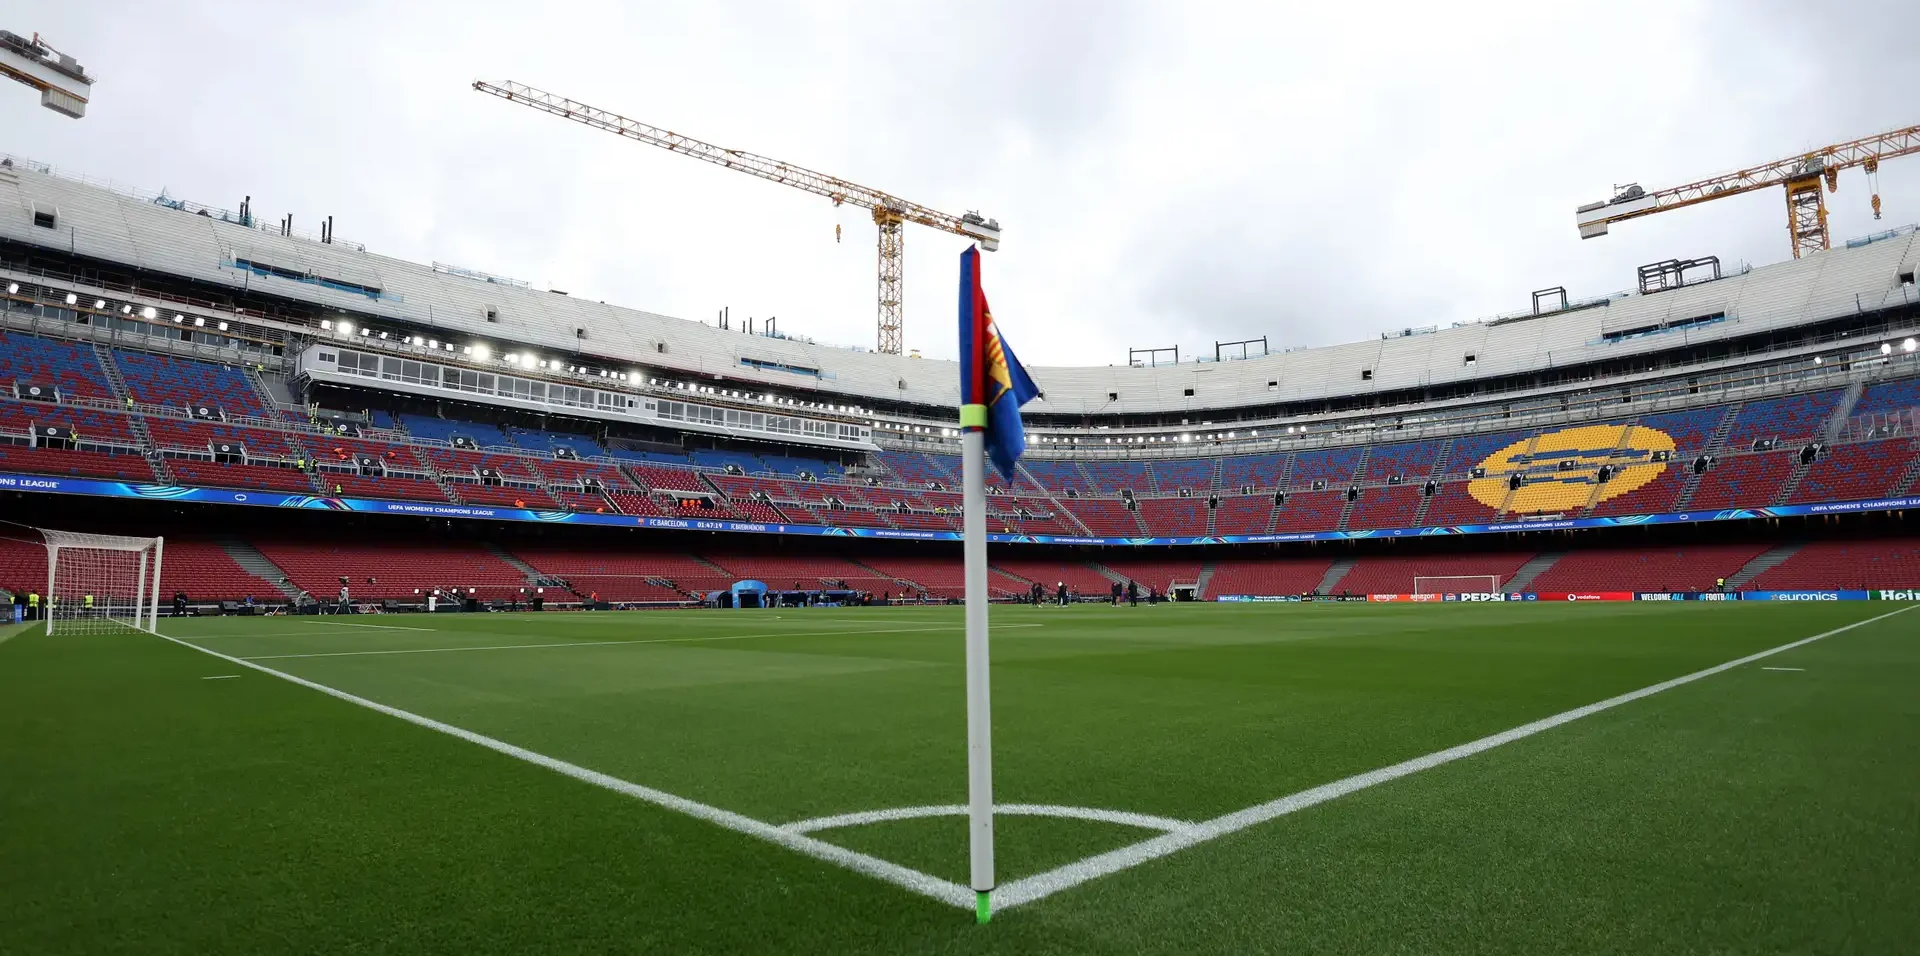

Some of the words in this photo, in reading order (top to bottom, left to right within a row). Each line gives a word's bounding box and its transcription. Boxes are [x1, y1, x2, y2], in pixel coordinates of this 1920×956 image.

[20, 480, 57, 488] LEAGUE
[1862, 500, 1906, 508] CHAMPIONS
[657, 519, 688, 528] BARCELONA
[697, 521, 722, 529] 01:47:19
[1461, 593, 1505, 601] PEPSI
[1779, 592, 1838, 600] euronics
